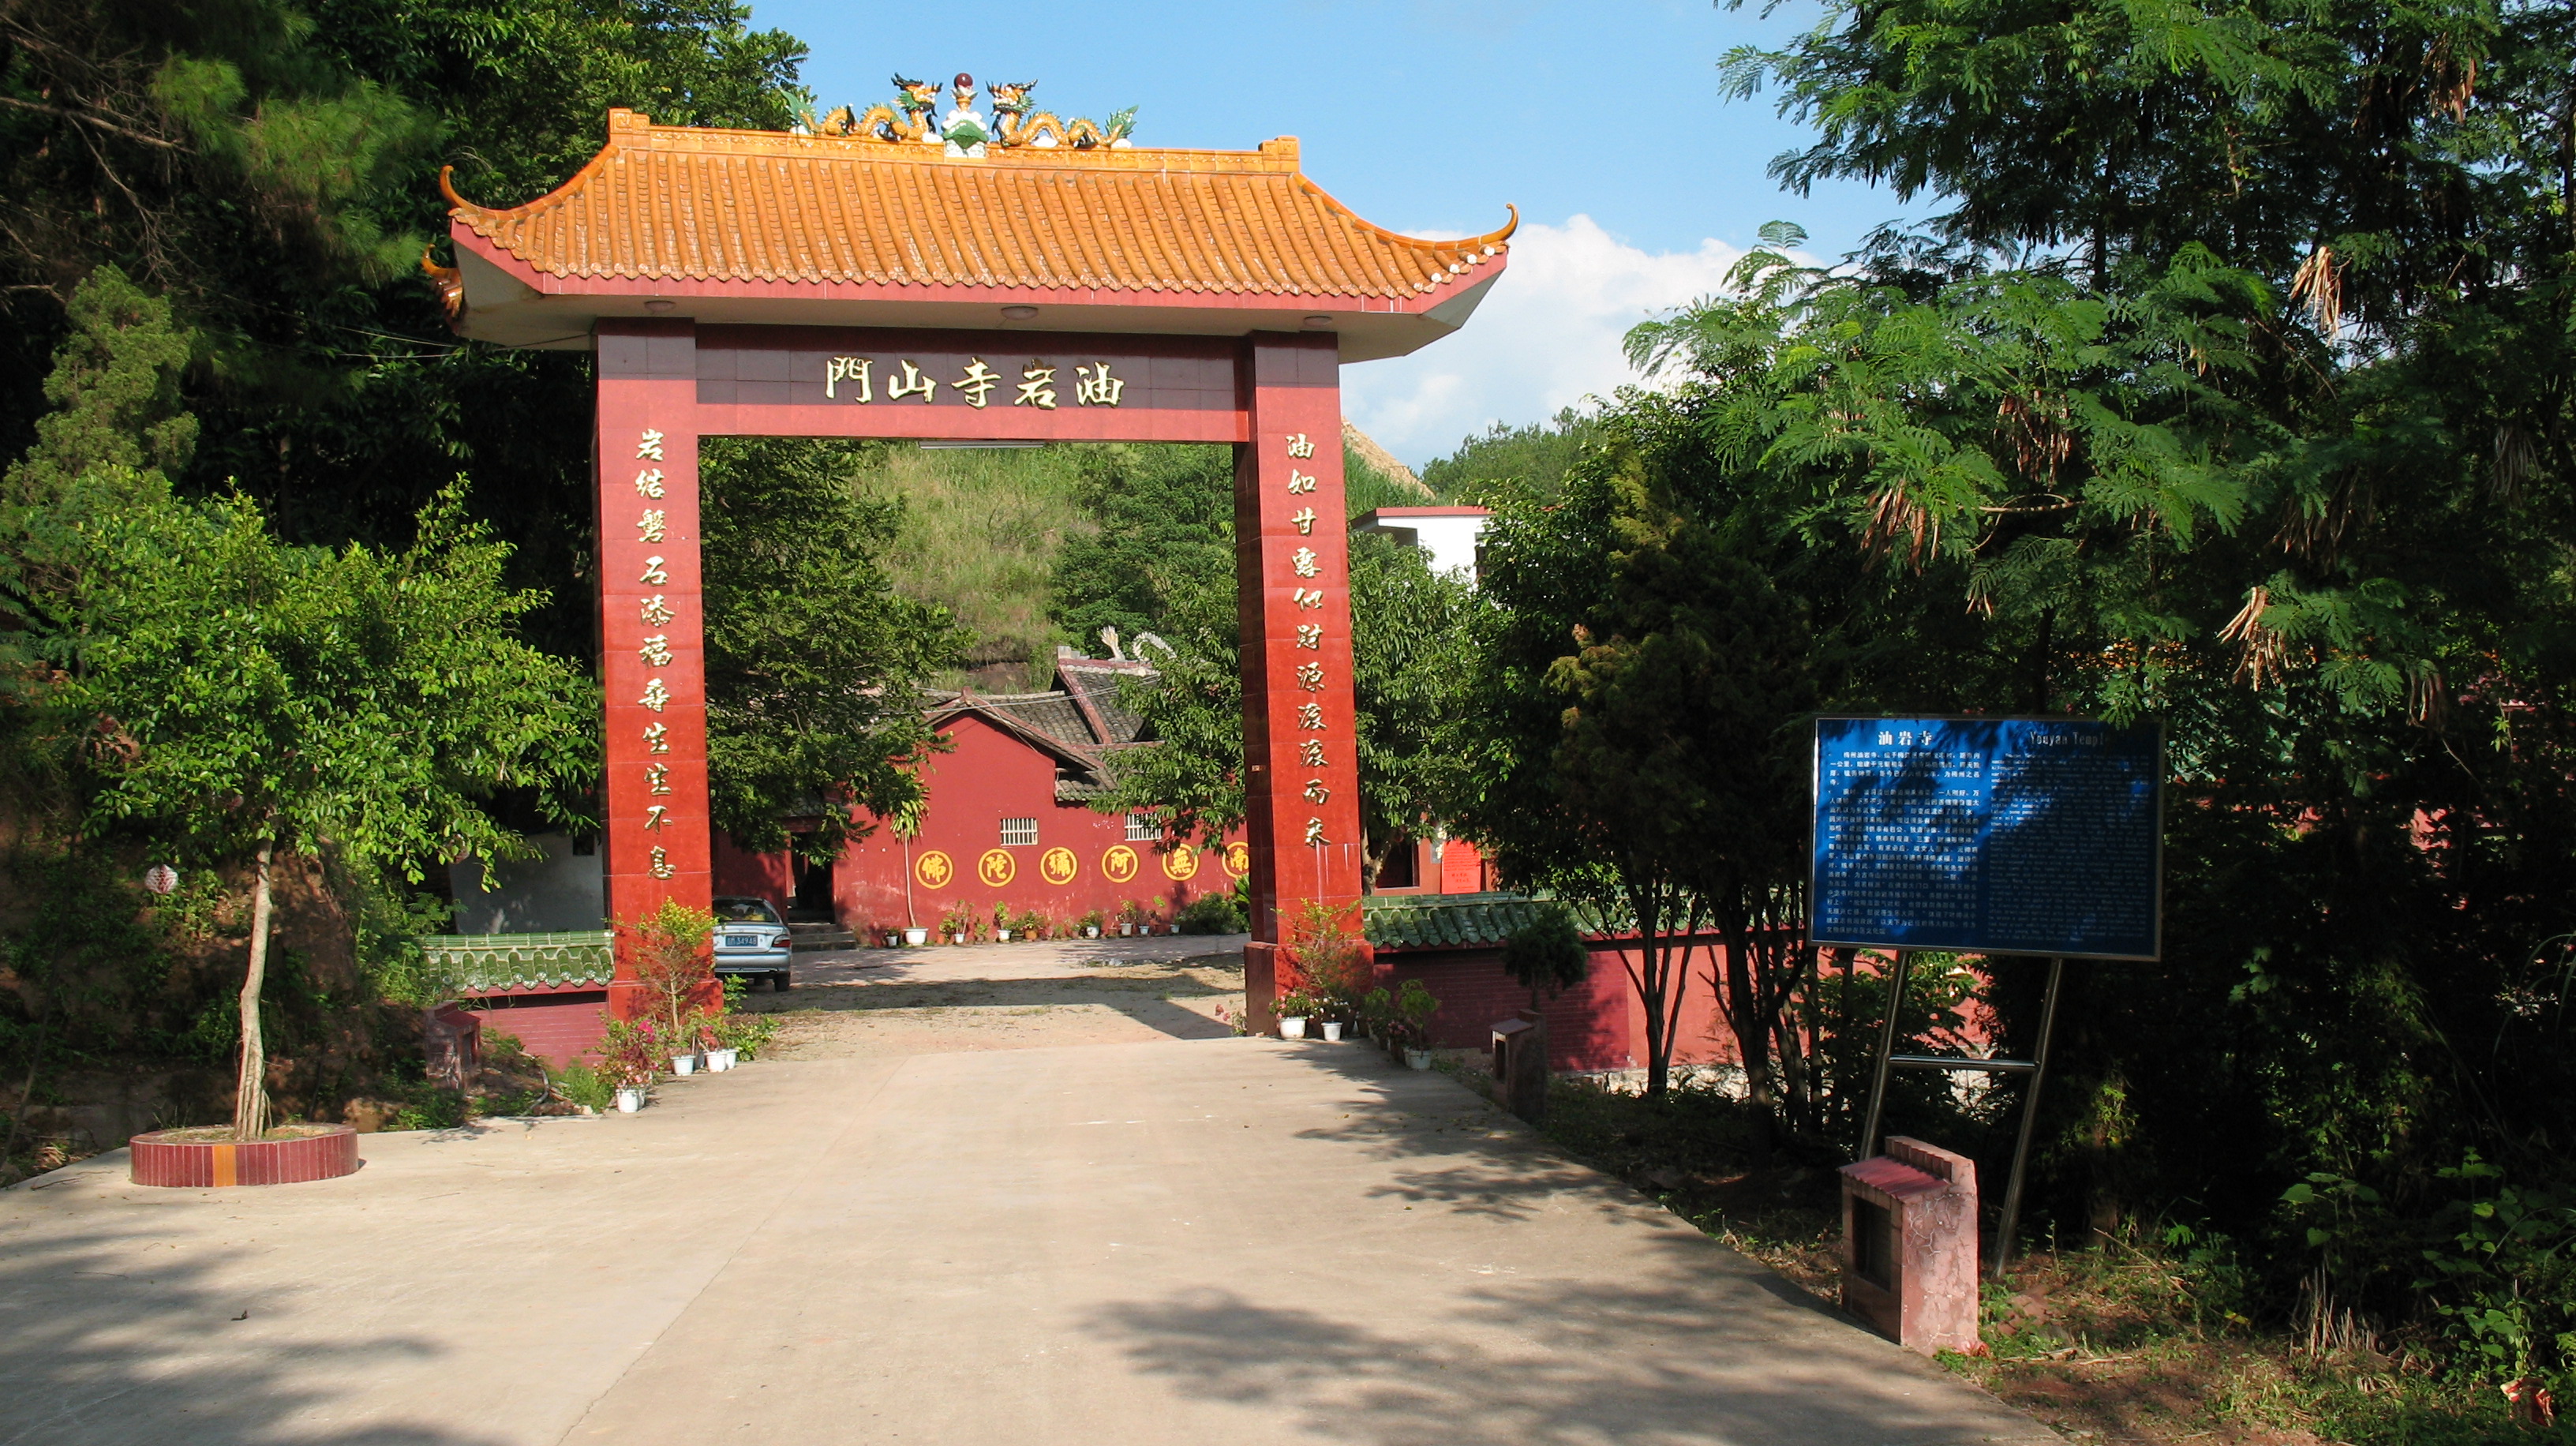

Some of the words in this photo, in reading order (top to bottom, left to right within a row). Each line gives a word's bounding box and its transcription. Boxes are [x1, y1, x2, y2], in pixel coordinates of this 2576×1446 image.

[1878, 731, 1932, 747] 油岩寺
[2030, 731, 2068, 747] Youyan
[2072, 732, 2108, 747] Templ
